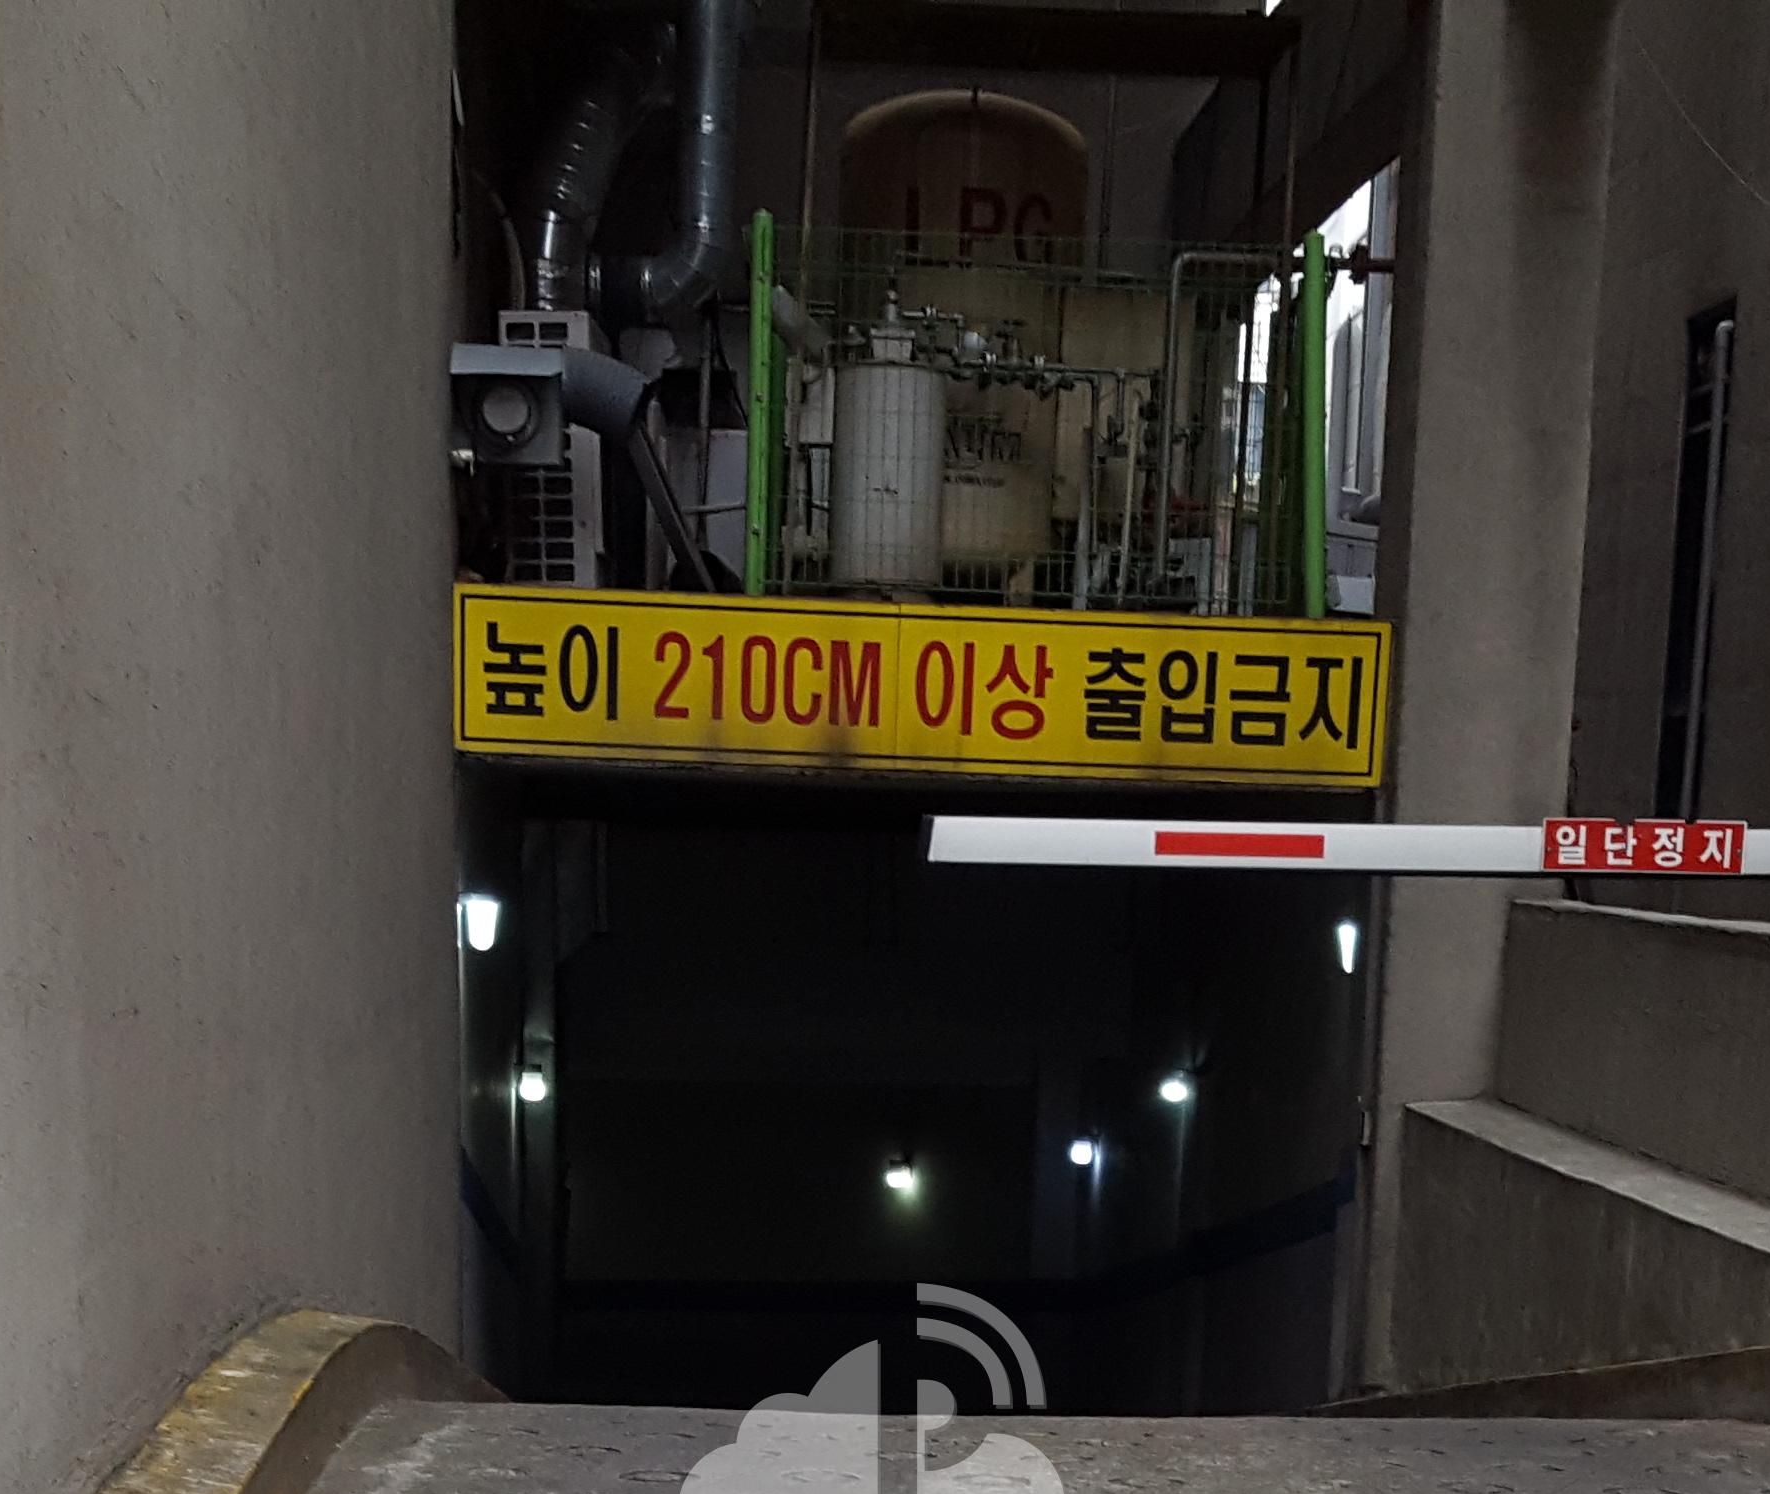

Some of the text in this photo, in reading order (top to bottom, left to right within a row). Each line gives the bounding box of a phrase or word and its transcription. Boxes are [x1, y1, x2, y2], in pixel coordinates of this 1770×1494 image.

[483, 621, 1363, 749] 높이 210CM 이상 출입금지
[1555, 824, 1733, 869] 일단정지
